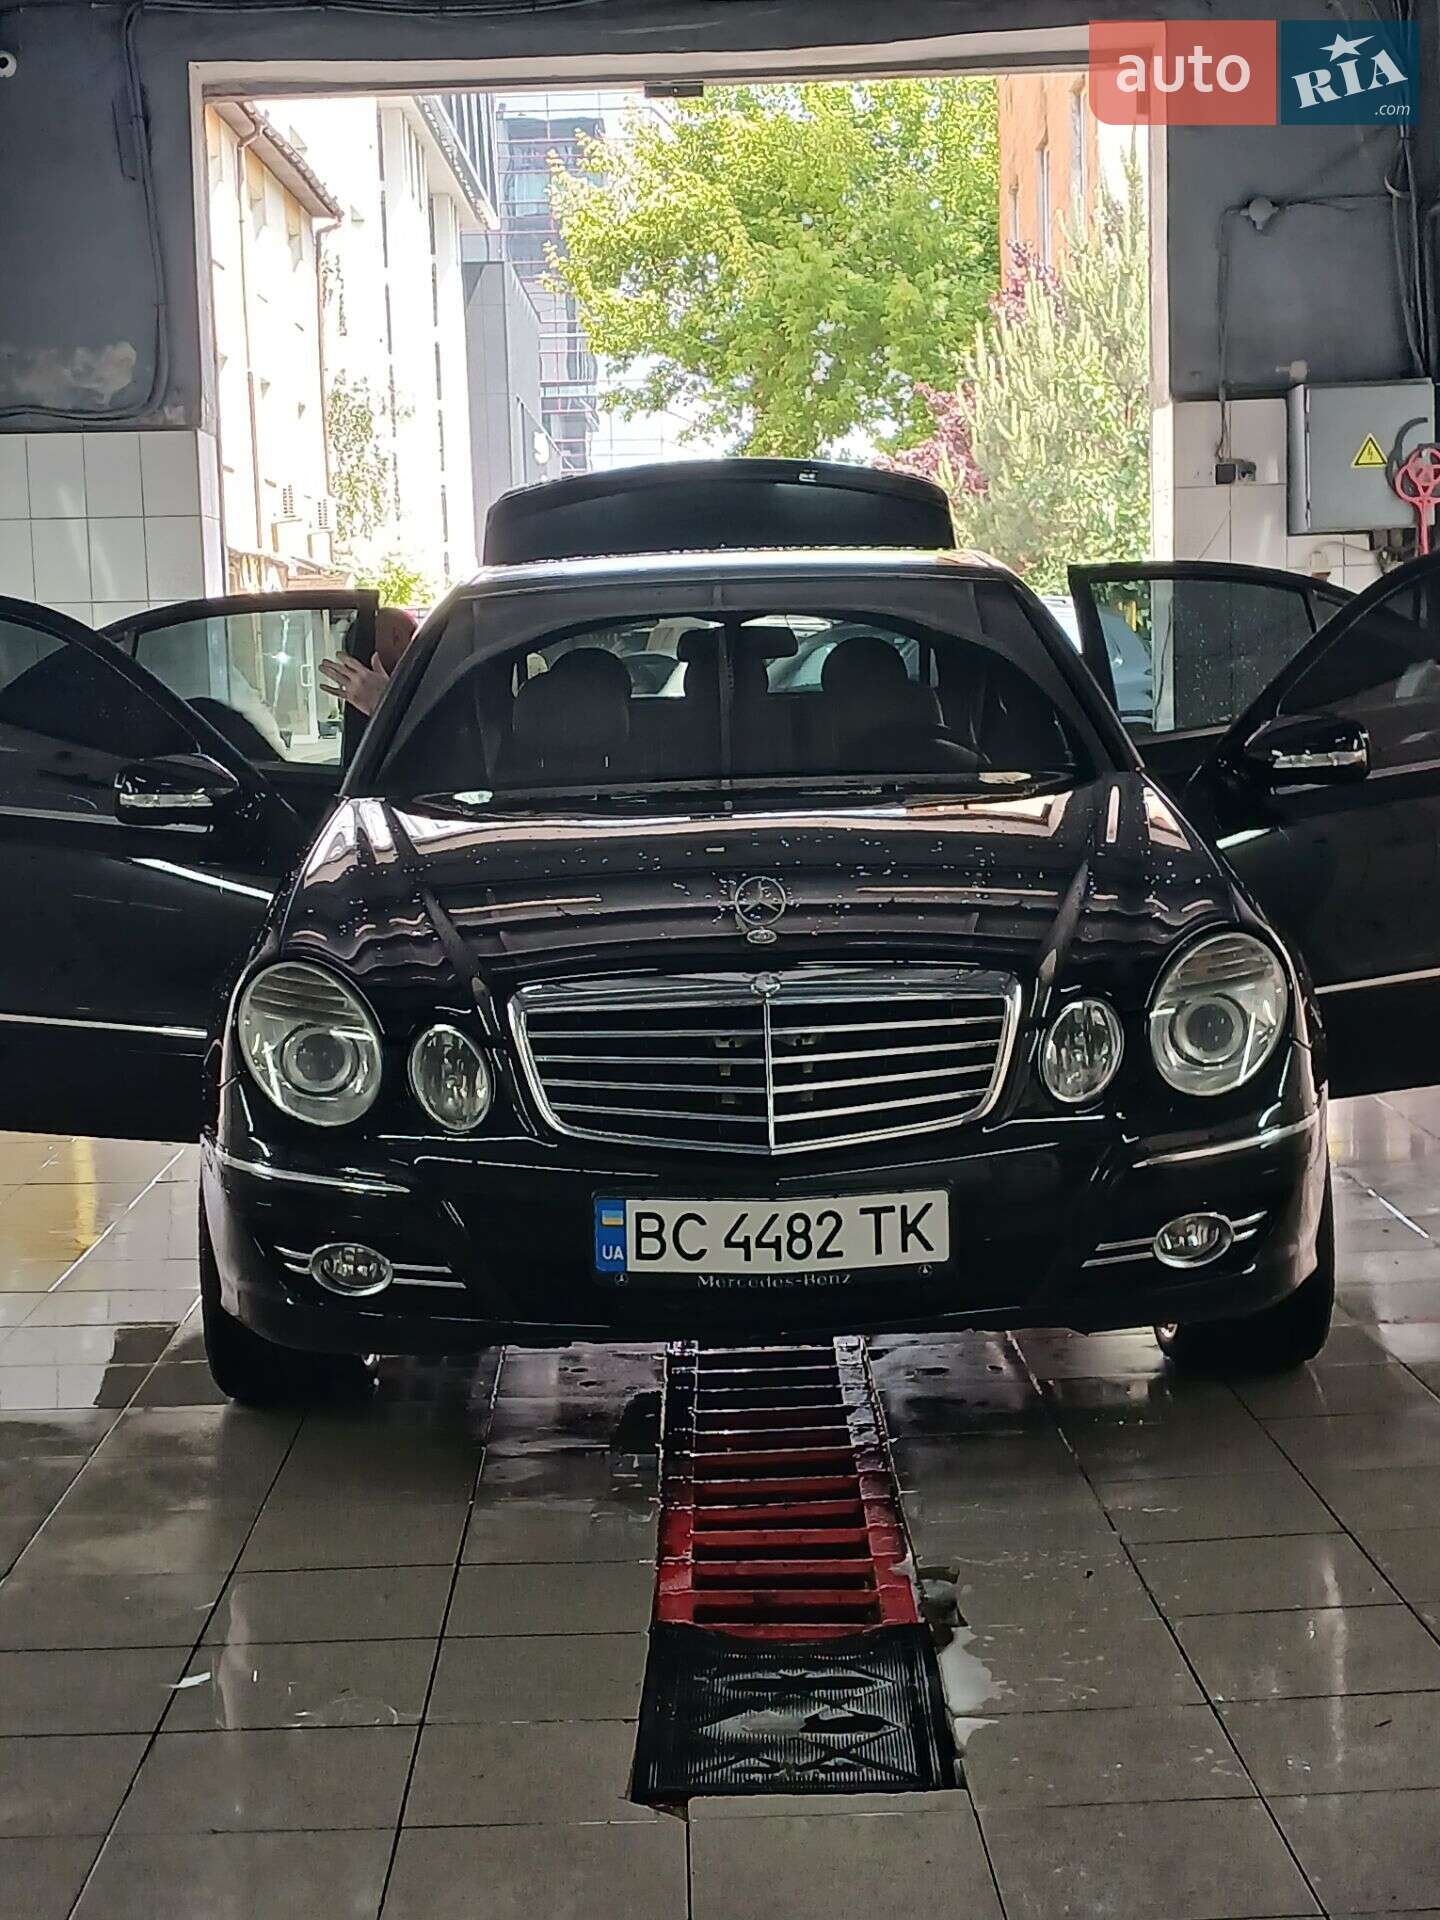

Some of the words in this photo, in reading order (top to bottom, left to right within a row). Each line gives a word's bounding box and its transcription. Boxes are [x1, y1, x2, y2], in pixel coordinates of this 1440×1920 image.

[635, 1212, 708, 1261] BC
[723, 1210, 844, 1262] 4482
[859, 1202, 935, 1255] TK
[602, 1245, 624, 1260] UA
[697, 1273, 851, 1288] Mercedes-Benz
